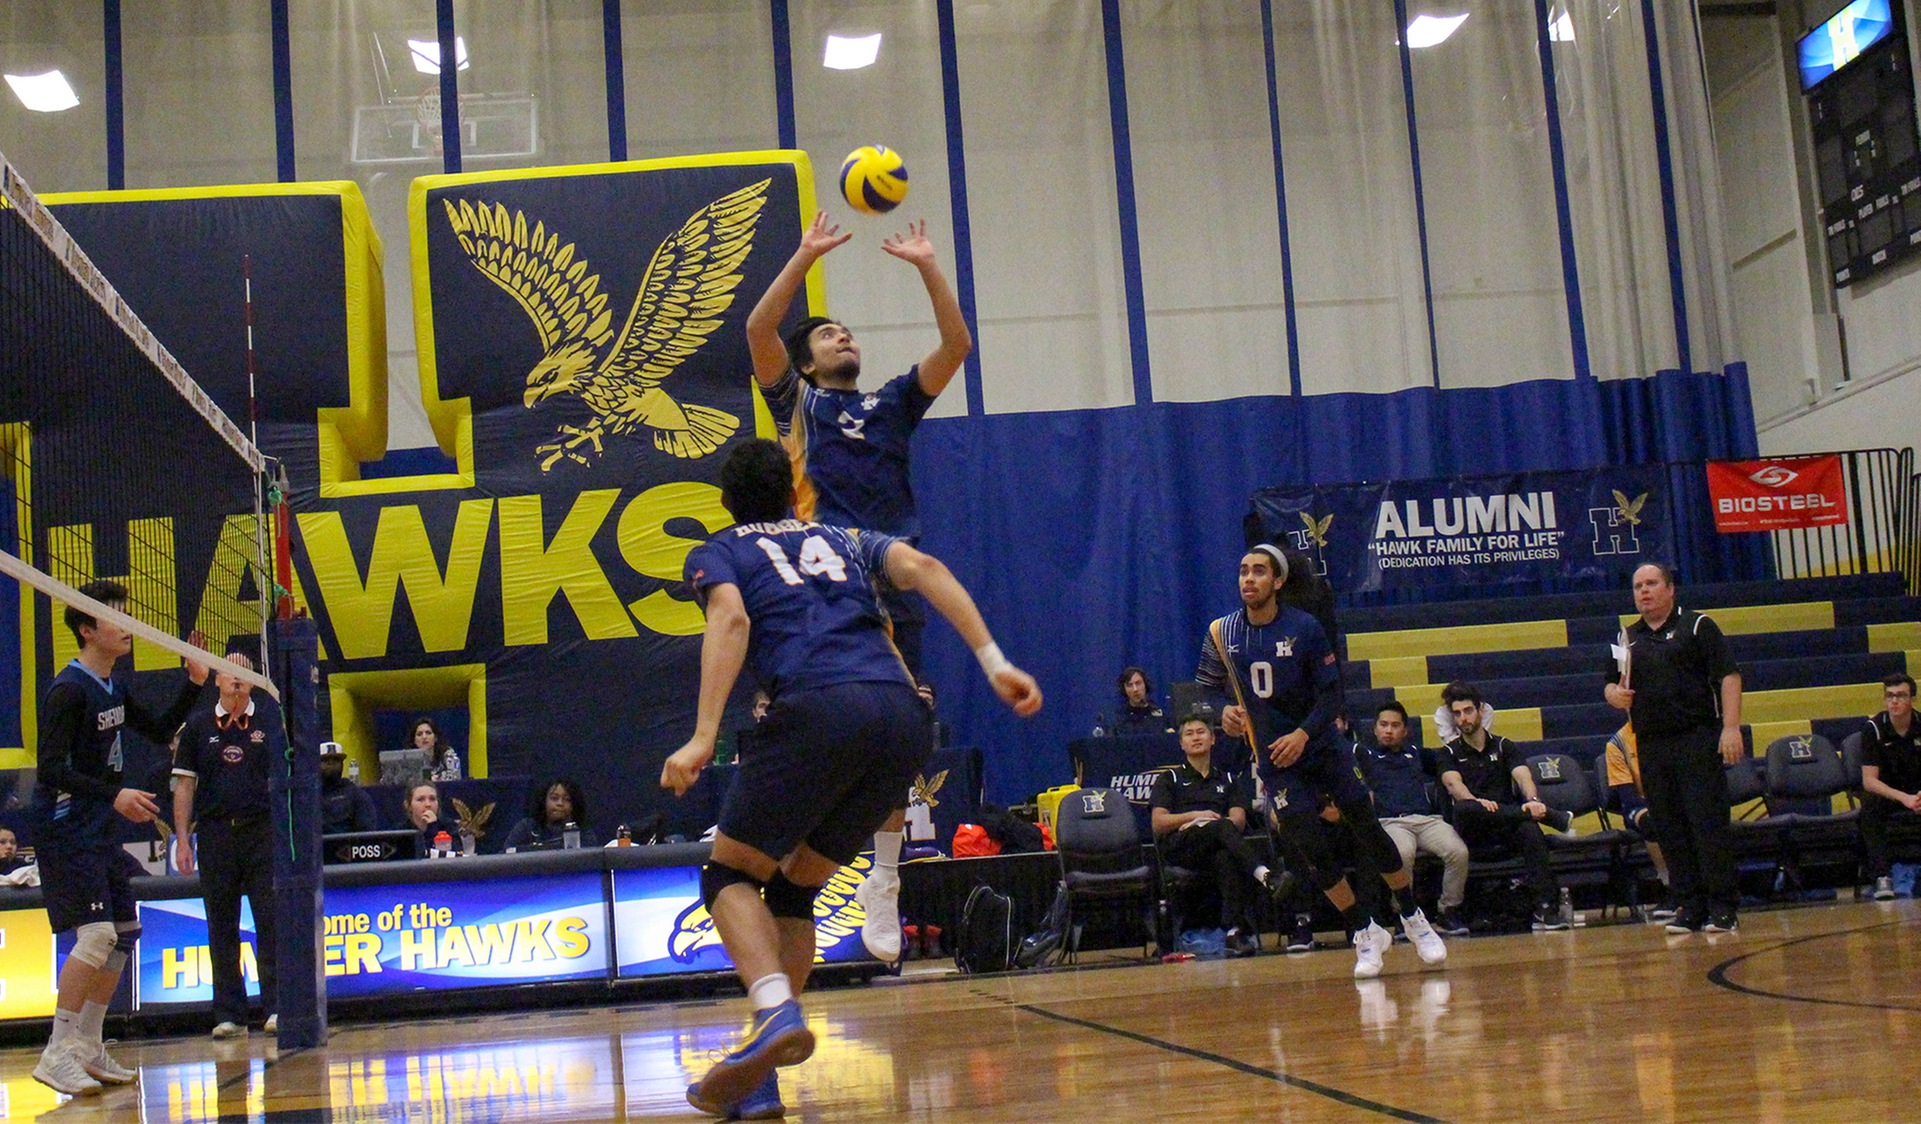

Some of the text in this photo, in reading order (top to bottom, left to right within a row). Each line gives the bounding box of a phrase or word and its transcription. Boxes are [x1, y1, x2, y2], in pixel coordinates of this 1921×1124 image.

[1375, 491, 1557, 540] ALUMNI
[1718, 493, 1836, 513] BIOSTEEL
[756, 535, 848, 586] 14
[1378, 548, 1560, 570] (DEDICATION HAS ITS PRIVILEGES)
[1427, 536, 1483, 553] FAMILY
[1487, 534, 1519, 550] FOR
[48, 481, 735, 678] HAWKS
[1250, 661, 1273, 699] 0
[107, 730, 124, 773] 4
[352, 845, 381, 859] POSS
[377, 904, 404, 931] of
[410, 903, 452, 928] the
[400, 916, 591, 971] HAWKS
